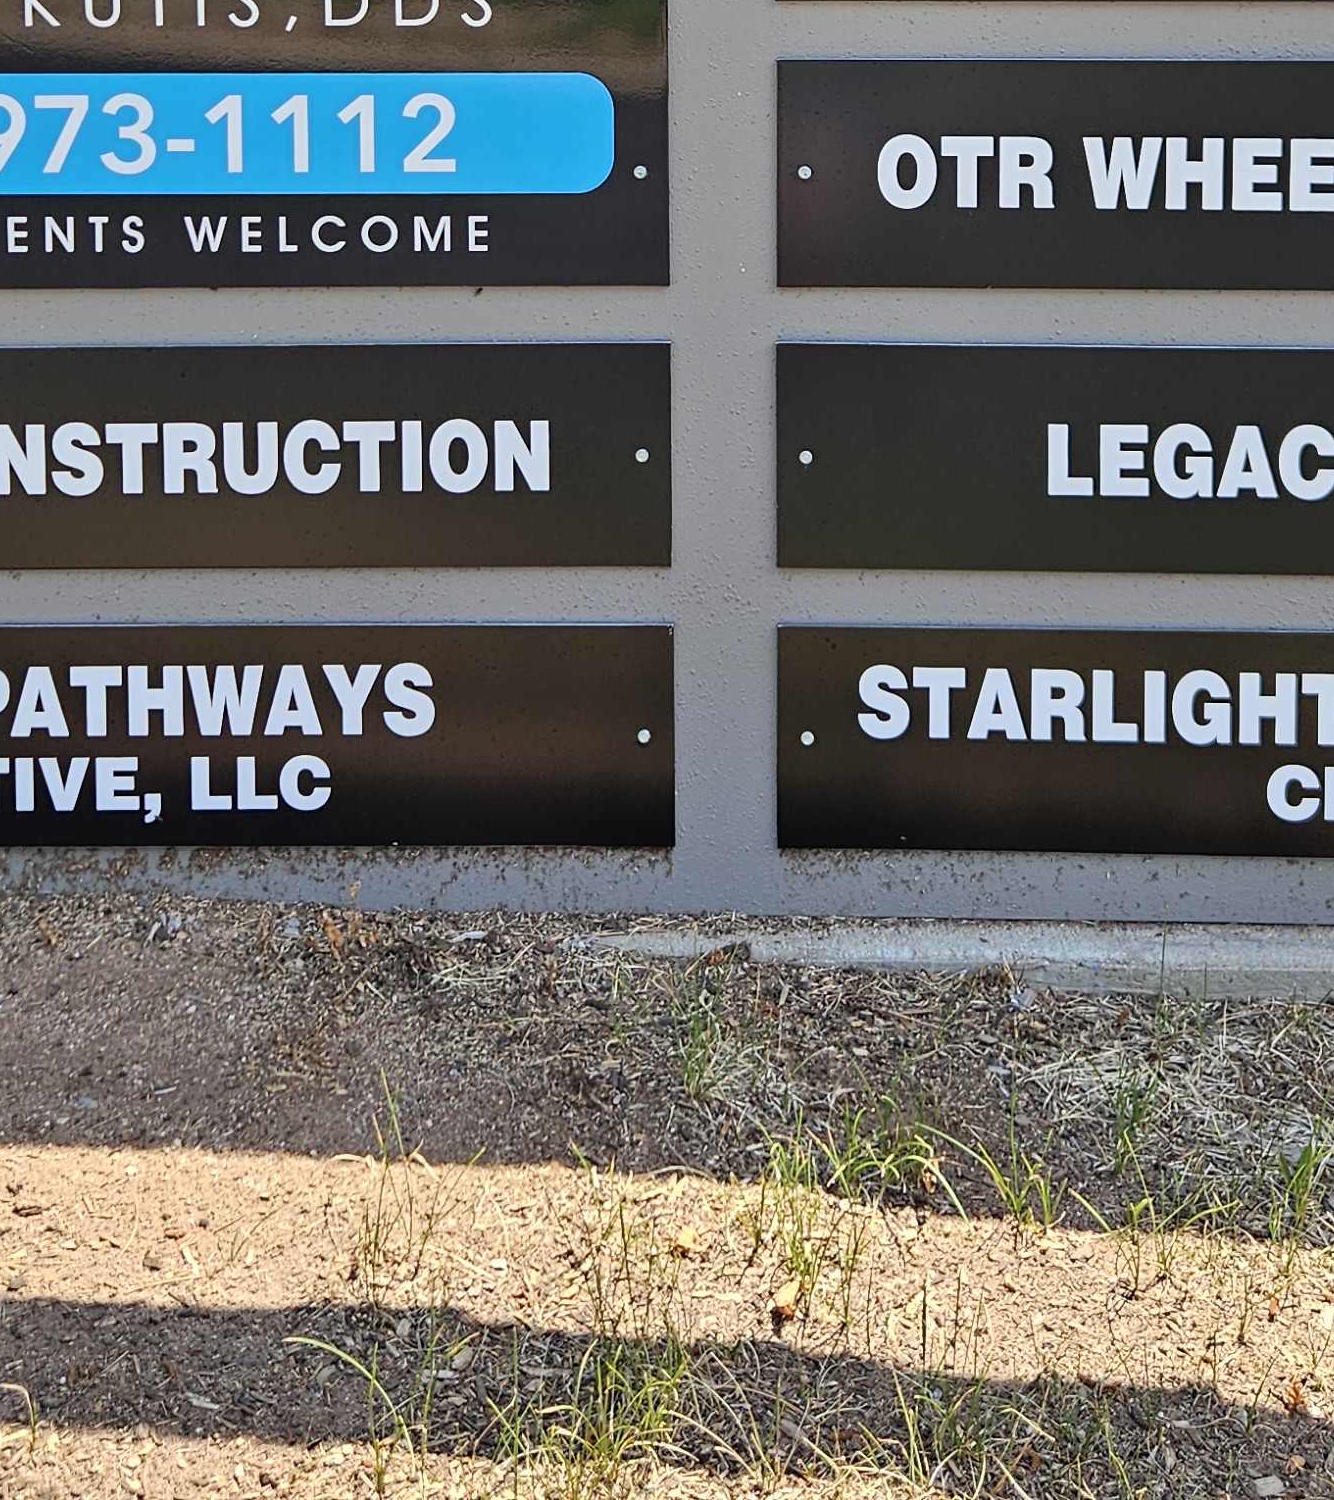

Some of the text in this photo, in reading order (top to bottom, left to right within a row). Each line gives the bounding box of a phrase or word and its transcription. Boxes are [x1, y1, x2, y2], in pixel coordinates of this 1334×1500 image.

[878, 134, 1054, 209] OTR
[184, 216, 488, 252] WELCOME
[191, 755, 331, 810] LLC
